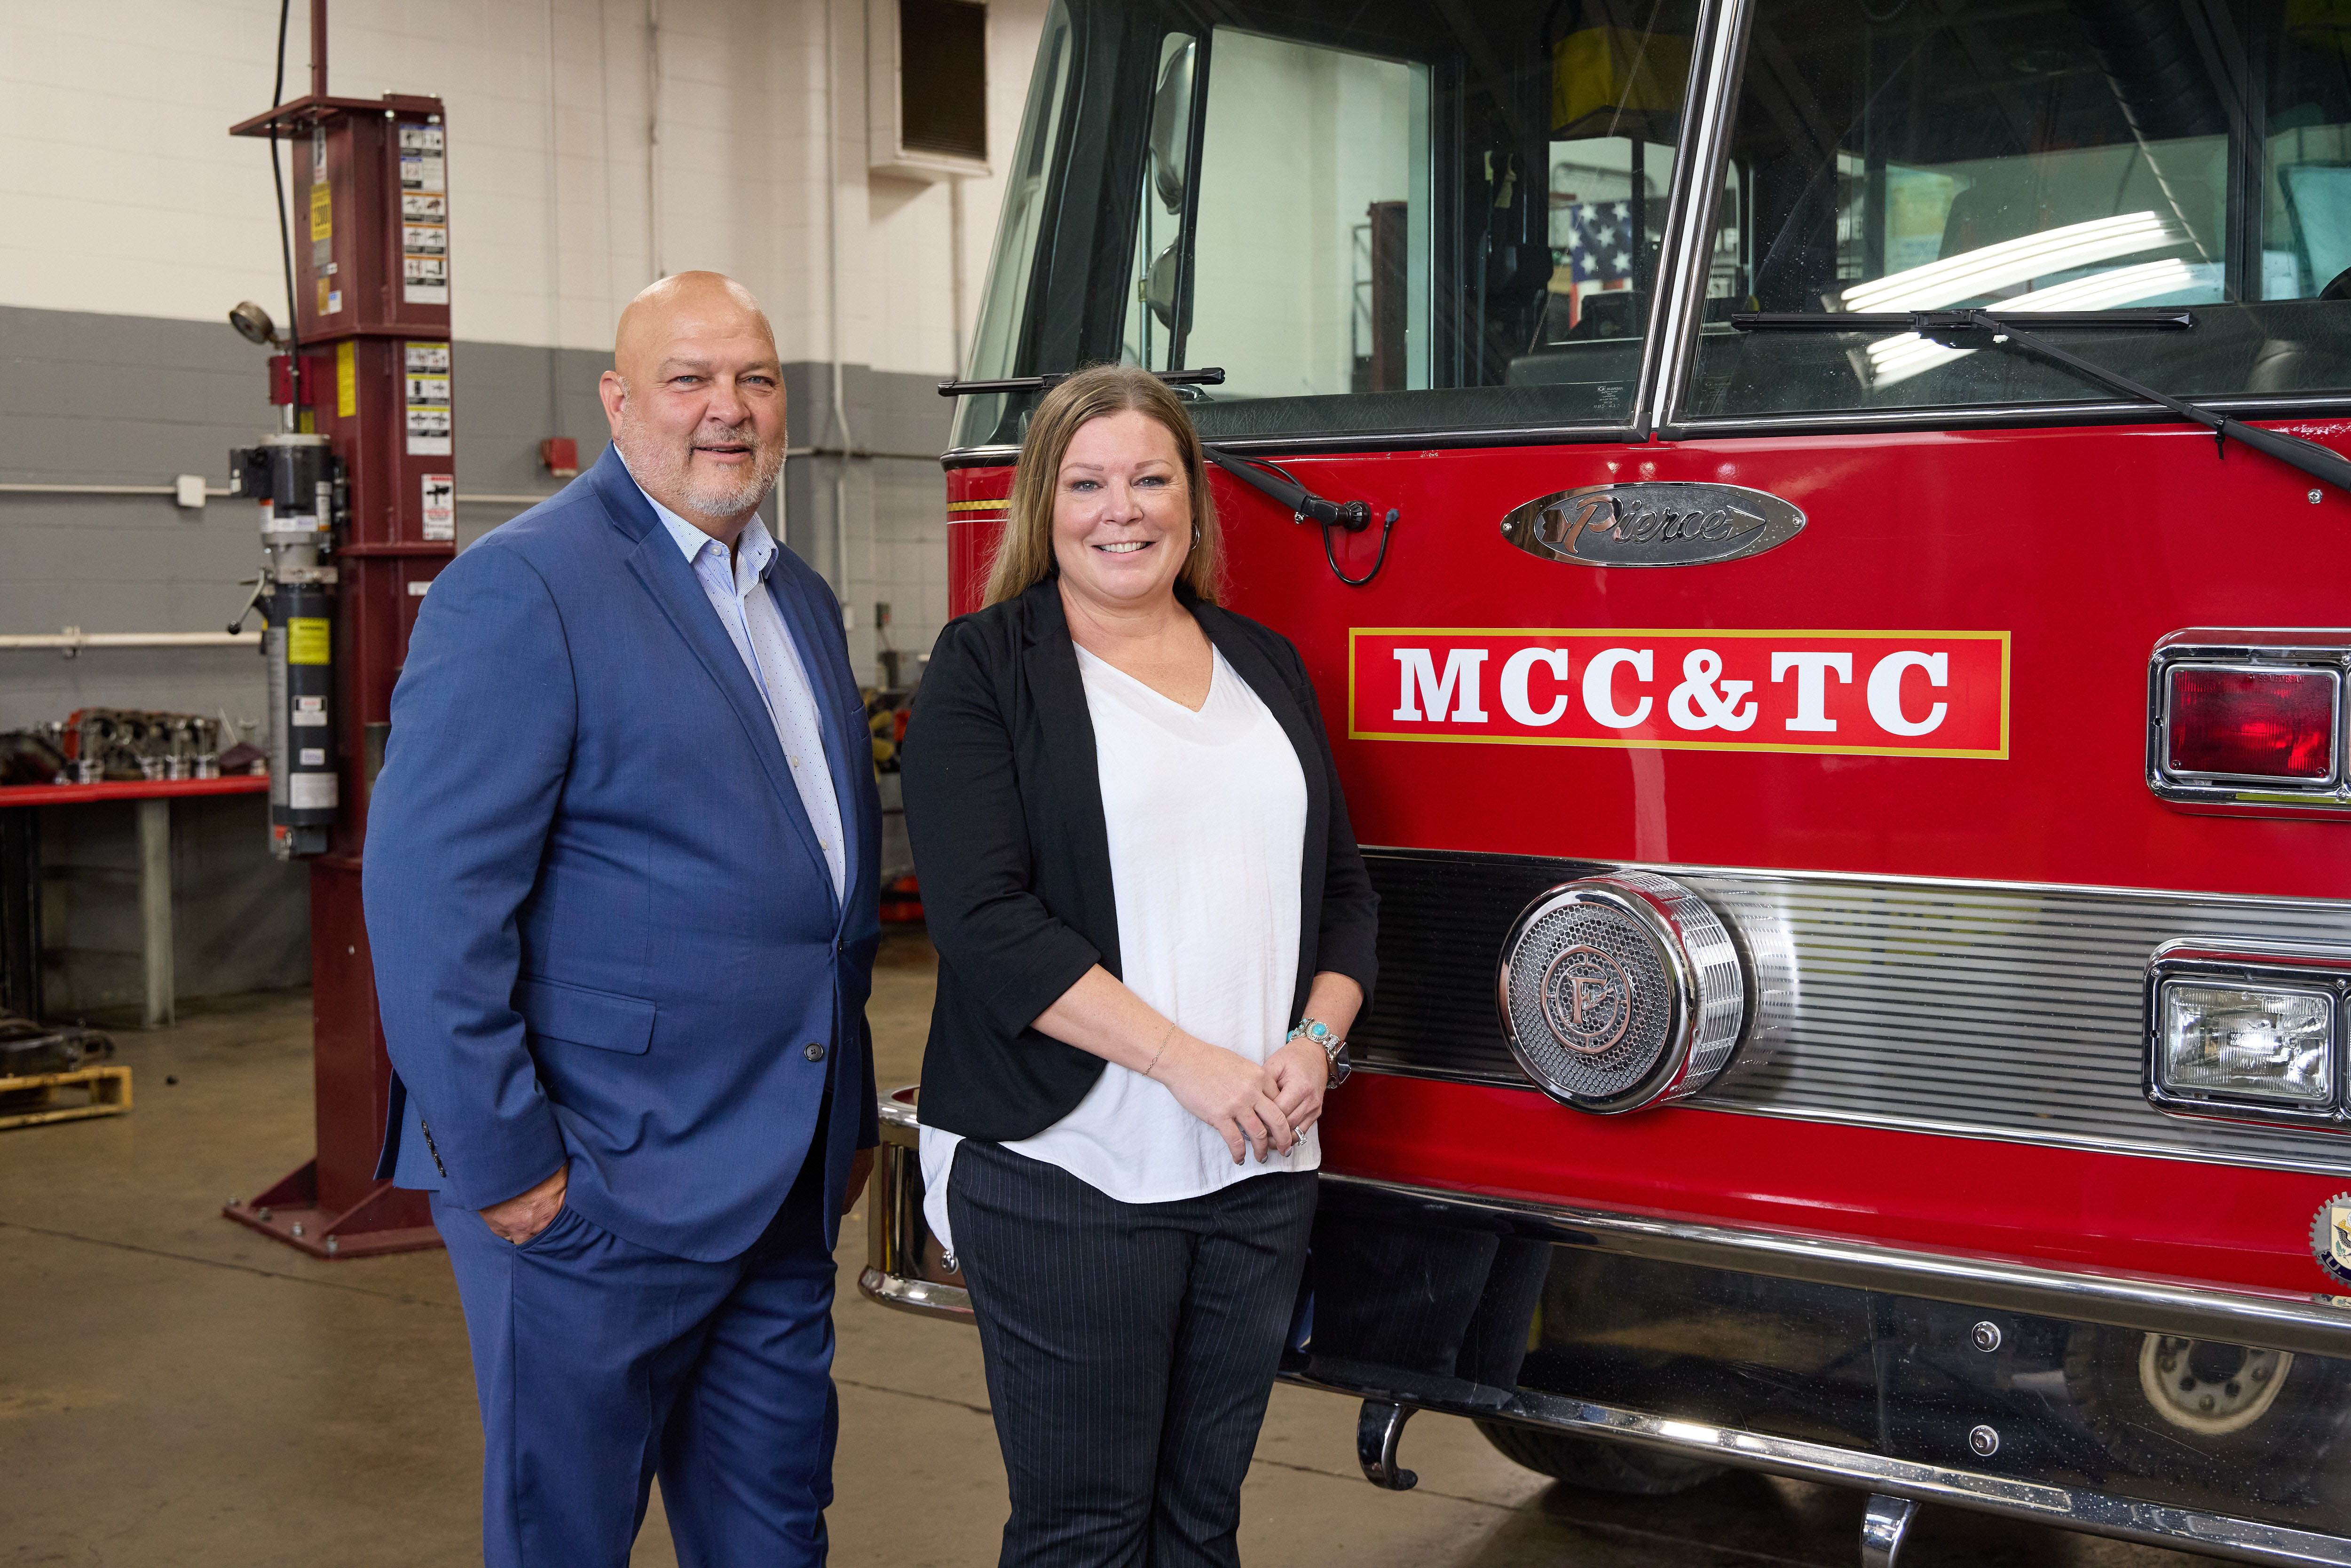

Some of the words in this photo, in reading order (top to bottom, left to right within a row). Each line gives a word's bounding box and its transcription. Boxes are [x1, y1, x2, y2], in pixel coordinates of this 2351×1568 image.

[1564, 494, 1729, 554] Pierce
[1393, 647, 1949, 736] MCC&TC
[2286, 675, 2304, 684] BEAM
